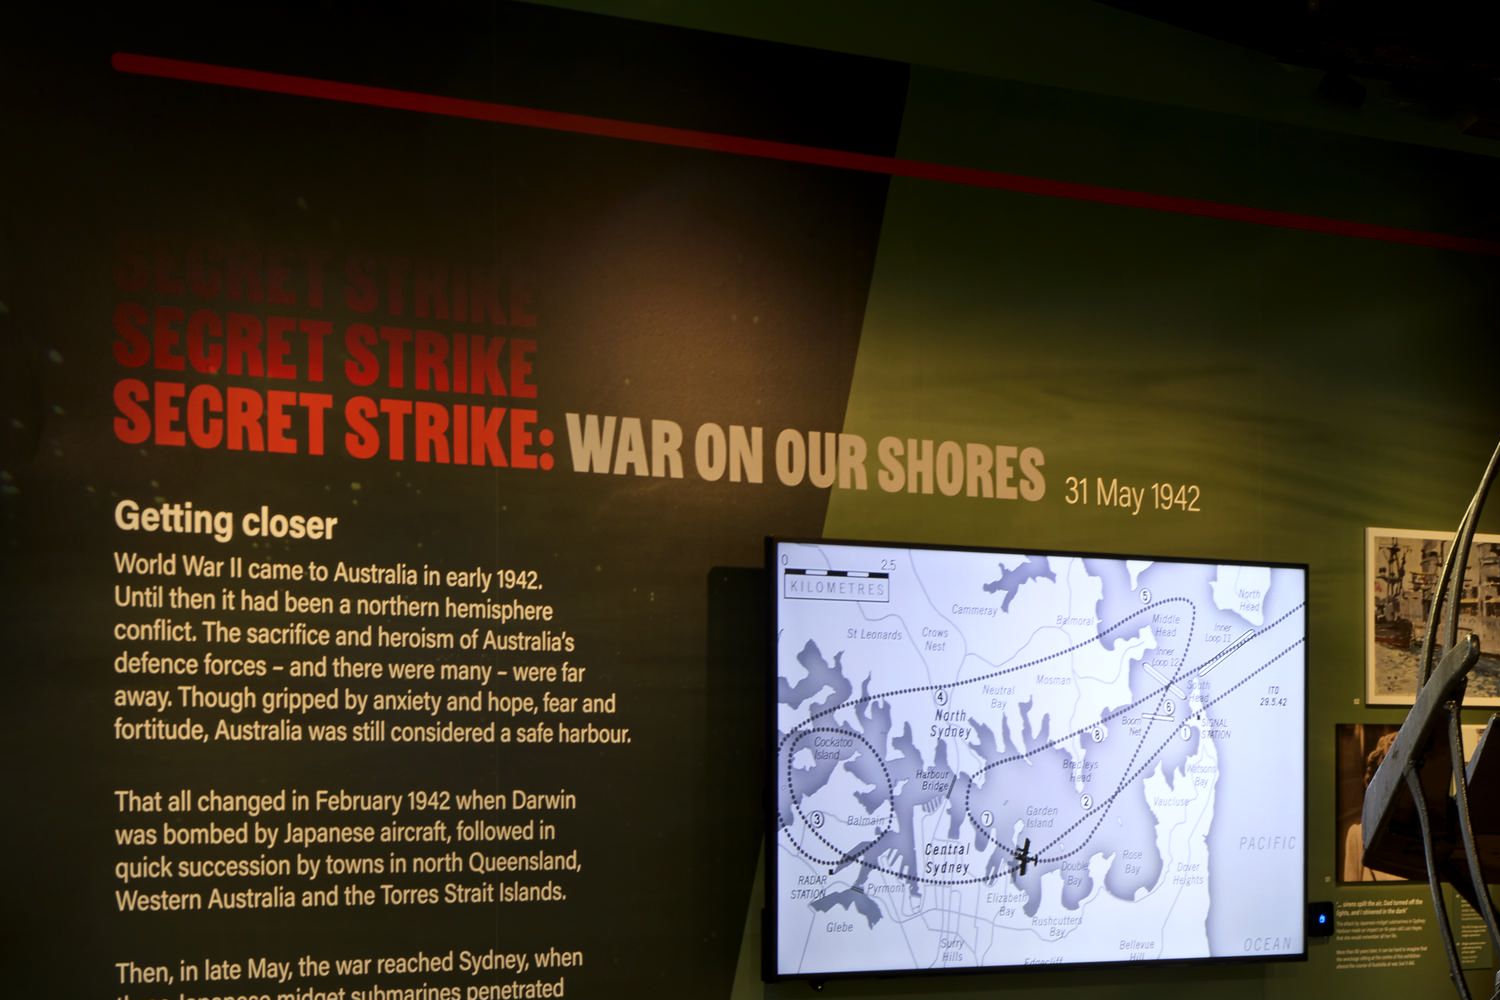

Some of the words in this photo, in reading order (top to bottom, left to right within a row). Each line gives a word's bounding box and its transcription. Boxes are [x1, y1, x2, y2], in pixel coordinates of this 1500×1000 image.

[113, 303, 332, 382] SECRET
[345, 323, 537, 399] STRIKE
[113, 379, 332, 456] SECRET
[345, 396, 554, 471] STRIKE:
[566, 413, 683, 478] WAR
[696, 423, 763, 483] ON
[777, 429, 867, 490] OUR
[879, 437, 1045, 501] SHORES
[1066, 477, 1086, 504] 31
[1097, 478, 1144, 514] May
[1152, 483, 1200, 511] 1942
[115, 500, 233, 542] Getting
[242, 506, 337, 539] closer
[781, 554, 788, 566] 0
[790, 580, 884, 596] KILOMETRES
[952, 604, 998, 617] Cammeray
[1152, 614, 1181, 625] Middle
[847, 628, 857, 639] St
[861, 629, 902, 640] Leonards
[922, 627, 949, 638] Crows
[925, 640, 946, 651] Nest
[982, 684, 1015, 695] Neutral
[991, 698, 1007, 711] Bay
[935, 709, 966, 721] North
[930, 724, 971, 740] Sydney
[814, 736, 853, 748] Cockatoo
[815, 749, 840, 760] Island
[1063, 758, 1099, 772] Bradleys
[916, 769, 949, 780] Harbour
[922, 781, 949, 793] Bridge
[114, 790, 162, 811] That
[168, 790, 191, 811] all
[198, 790, 285, 816] changed
[293, 790, 309, 810] in
[317, 790, 402, 815] February
[408, 791, 450, 810] 1942
[456, 789, 506, 809] when
[513, 789, 576, 809] Darwin
[1026, 805, 1058, 817] Garden
[847, 815, 884, 826] Balmain
[1027, 818, 1054, 829] Island
[115, 829, 157, 845] was
[164, 822, 247, 844] bombed
[255, 822, 278, 848] by
[284, 823, 375, 848] Japanese
[381, 820, 451, 844] aircraft,
[457, 820, 533, 841] followed
[540, 820, 555, 839] in
[1239, 836, 1296, 850] PACIFIC
[925, 843, 969, 857] Central
[1123, 849, 1143, 860] Rose
[116, 856, 172, 883] quick
[179, 854, 290, 877] succession
[297, 854, 320, 880] by
[326, 856, 384, 874] towns
[391, 852, 406, 872] in
[413, 852, 462, 872] north
[469, 850, 581, 874] Queensland,
[925, 861, 970, 877] Sydney
[1125, 863, 1141, 876] Bay
[798, 875, 827, 886] RADAR
[1067, 875, 1082, 888] Bay
[790, 888, 826, 900] STATION
[867, 882, 905, 896] Pyrmont
[116, 890, 201, 911] Western
[208, 886, 295, 909] Australia
[302, 885, 338, 907] and
[344, 885, 375, 905] the
[381, 885, 439, 904] Torres
[445, 882, 494, 903] Strait
[500, 881, 566, 902] Islands.
[986, 892, 1027, 904] Elizabeth
[1000, 905, 1016, 918] Bay
[826, 922, 854, 934] Glebe
[1049, 926, 1065, 939] Bay
[939, 938, 964, 951] Surry
[1119, 939, 1155, 950] Bellevue
[1243, 937, 1291, 951] OCEAN
[942, 951, 963, 963] Hills
[115, 962, 173, 984] Then,
[181, 960, 197, 981] in
[206, 959, 241, 980] late
[249, 958, 292, 983] May,
[298, 956, 330, 976] the
[336, 959, 372, 975] war
[378, 951, 453, 973] reached
[460, 949, 529, 975] Sydney,
[535, 947, 582, 967] when
